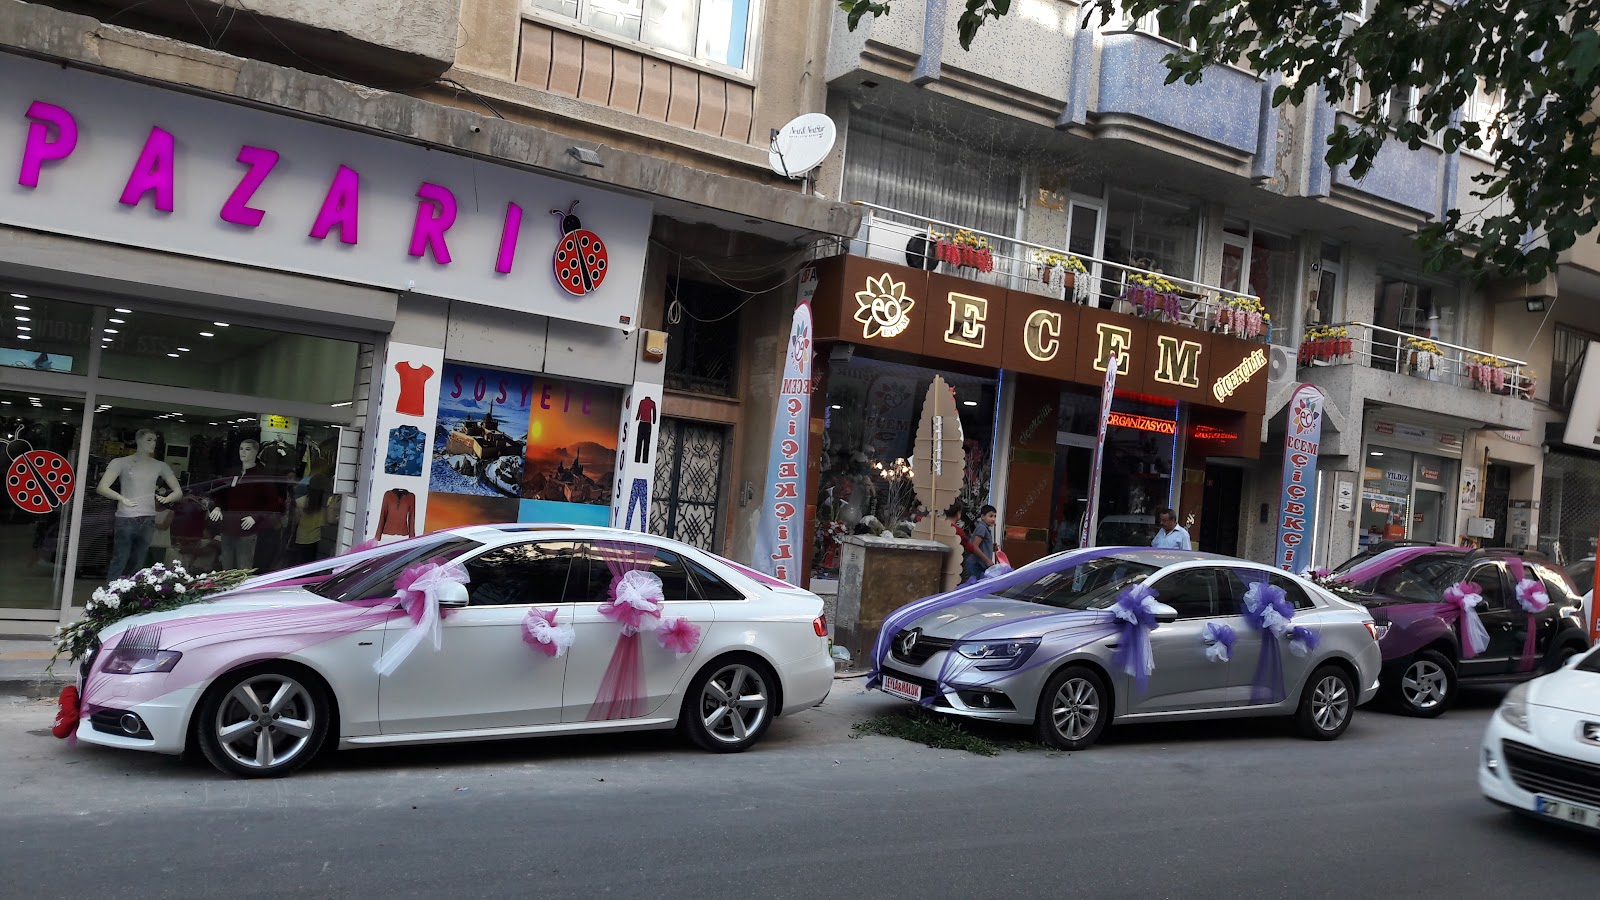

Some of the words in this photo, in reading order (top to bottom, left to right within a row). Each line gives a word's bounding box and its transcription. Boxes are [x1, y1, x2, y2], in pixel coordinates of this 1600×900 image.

[18, 100, 523, 274] PAZARI
[944, 291, 1202, 388] ECEM
[450, 371, 592, 417] SOSYETE
[1287, 435, 1318, 456] ECEM
